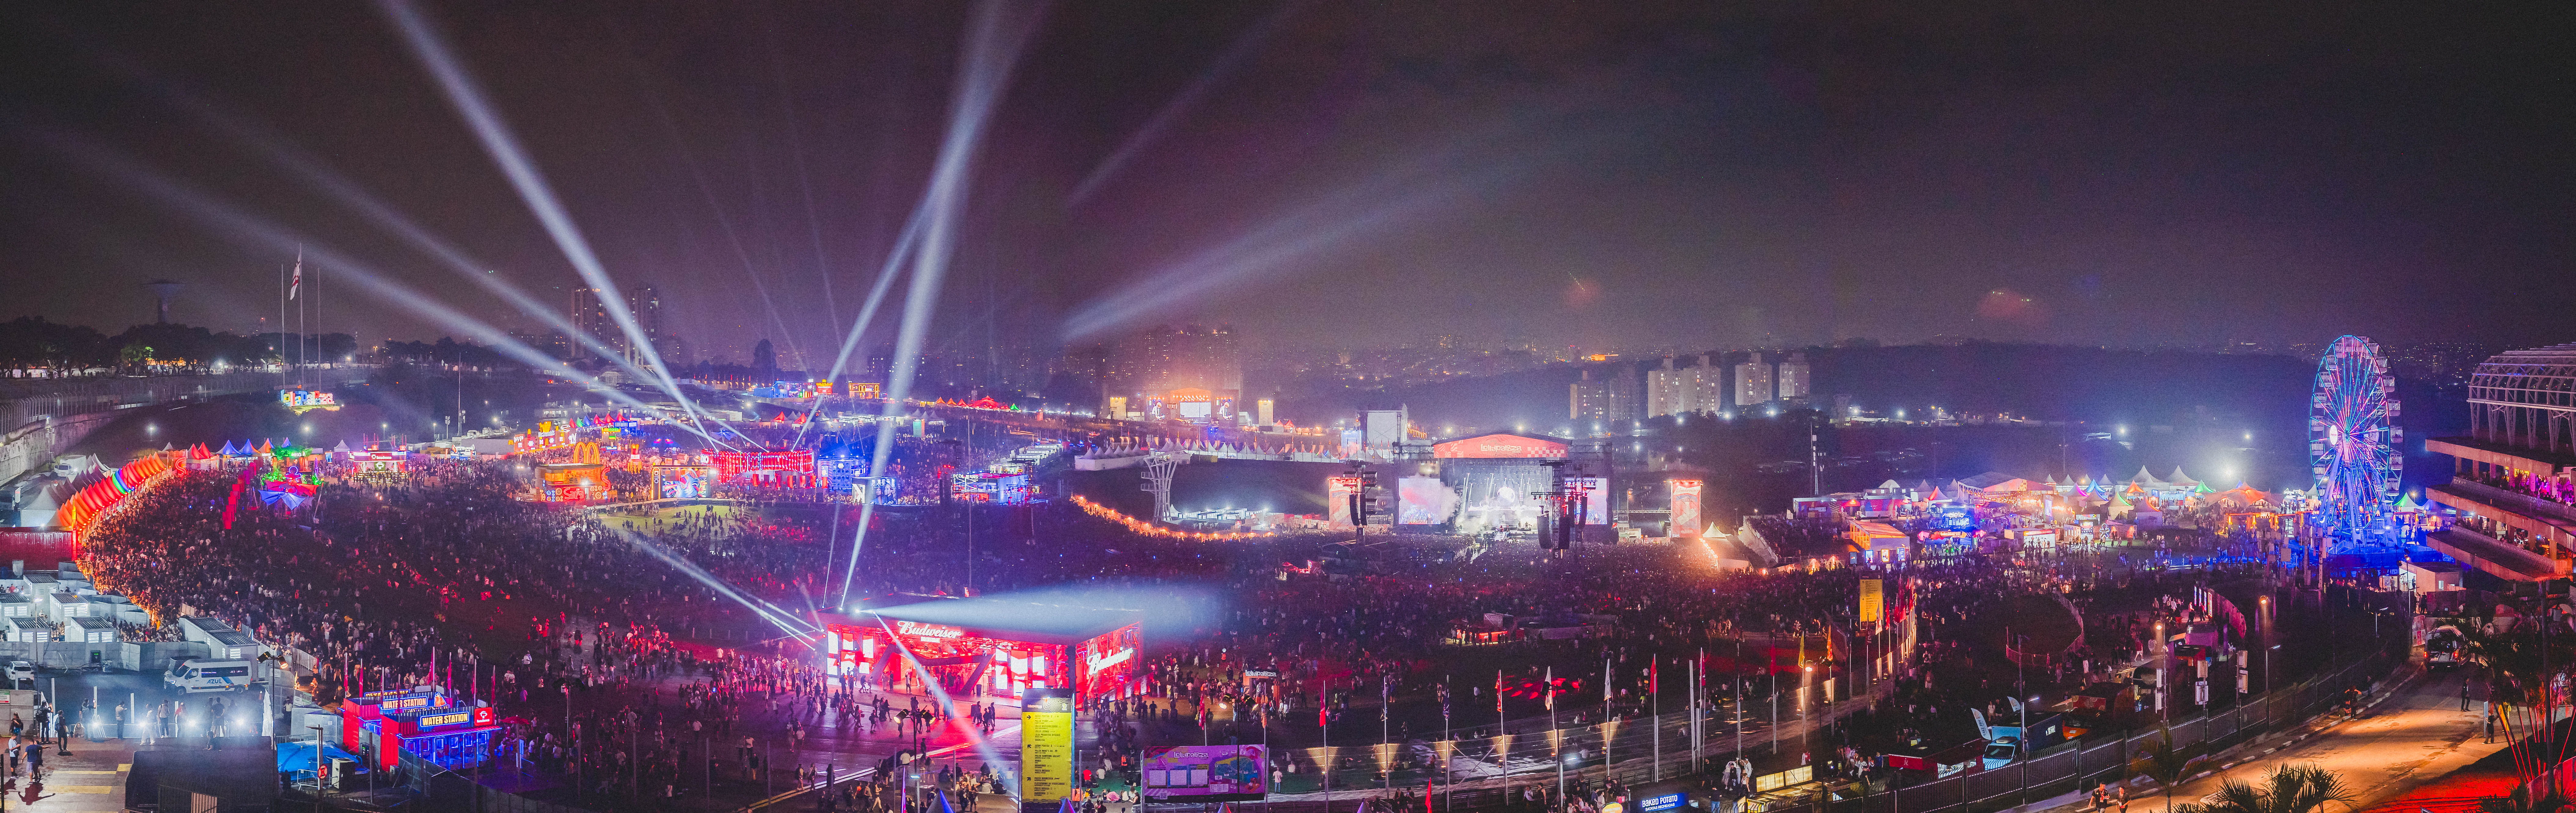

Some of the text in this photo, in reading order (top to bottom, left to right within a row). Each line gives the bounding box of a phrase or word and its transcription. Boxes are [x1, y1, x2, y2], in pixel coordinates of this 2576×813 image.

[1481, 444, 1523, 452] Lollapalooza
[563, 487, 584, 500] Sadia
[897, 621, 962, 638] Budweiser
[403, 698, 426, 707] STATION
[422, 713, 468, 726] WATER STATION
